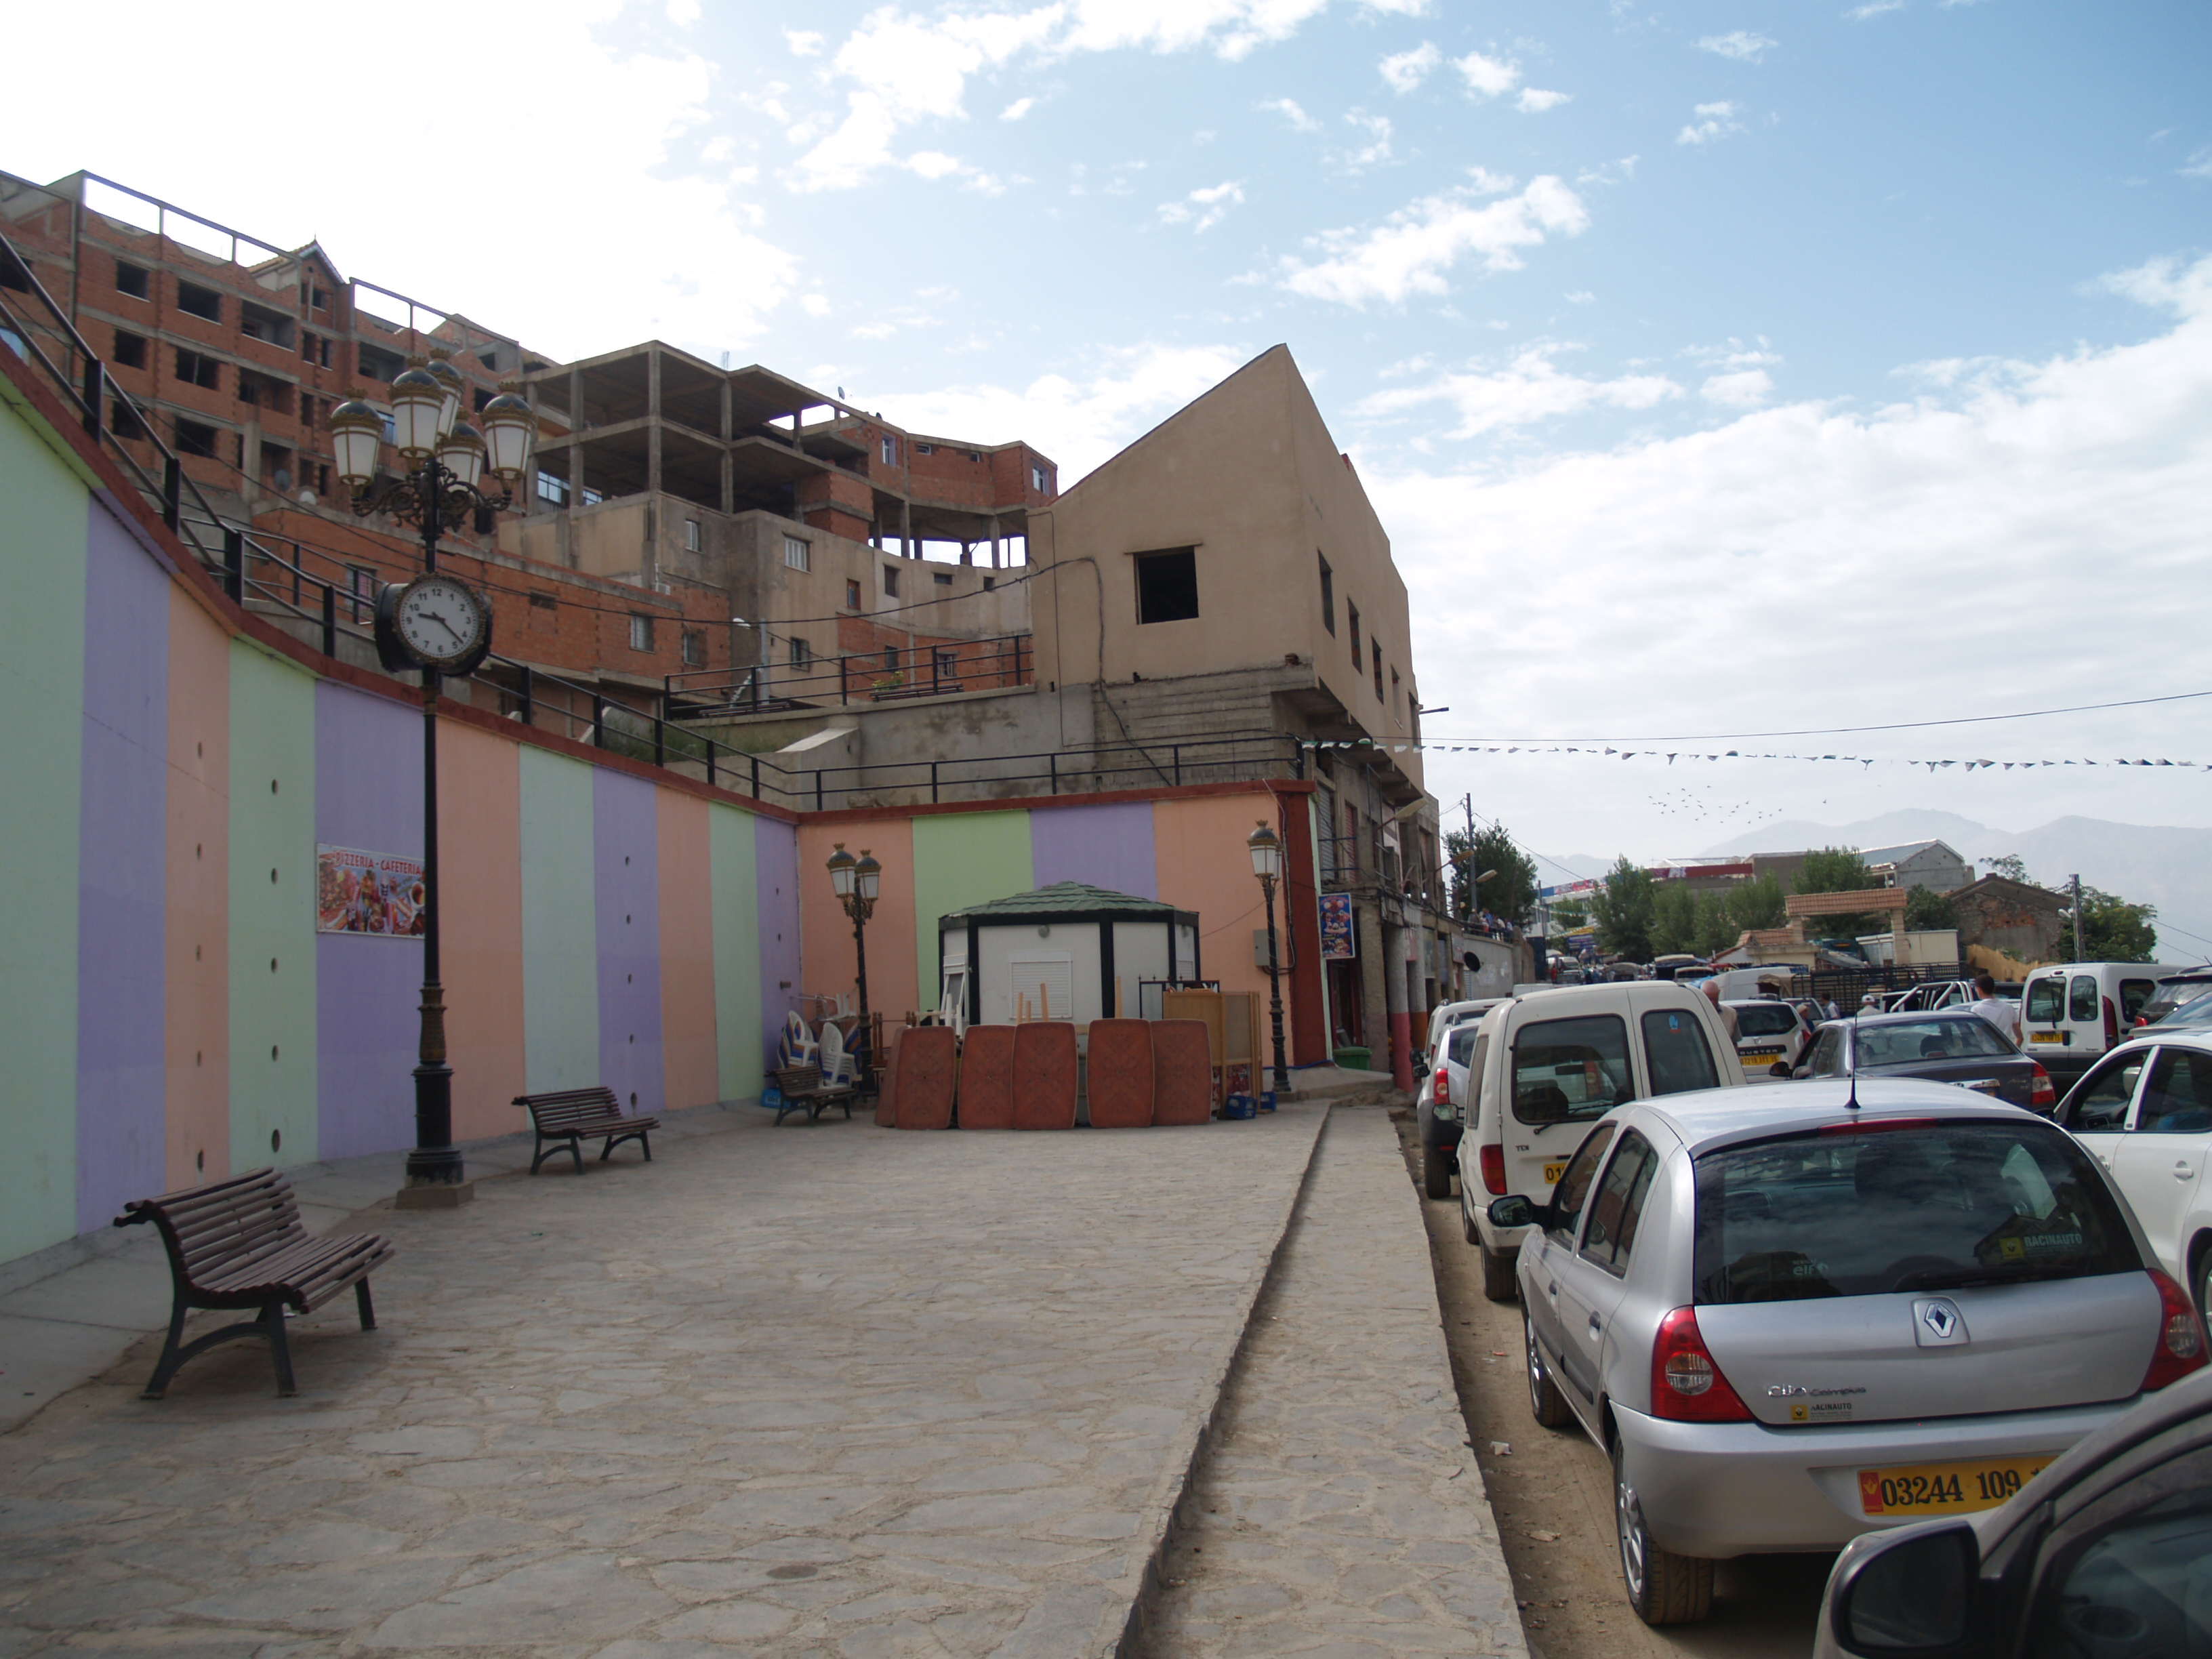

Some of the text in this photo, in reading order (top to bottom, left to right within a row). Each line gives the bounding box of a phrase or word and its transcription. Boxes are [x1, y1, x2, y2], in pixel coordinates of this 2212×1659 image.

[417, 592, 427, 600] 11
[432, 588, 442, 596] 12
[409, 603, 419, 611] 10
[335, 851, 374, 869] PIZZERIA
[380, 859, 422, 876] CAFETERIA
[1546, 1166, 1564, 1181] 01
[2024, 1233, 2083, 1247] RACINAUTO
[1881, 1469, 2022, 1507] 03244 109
